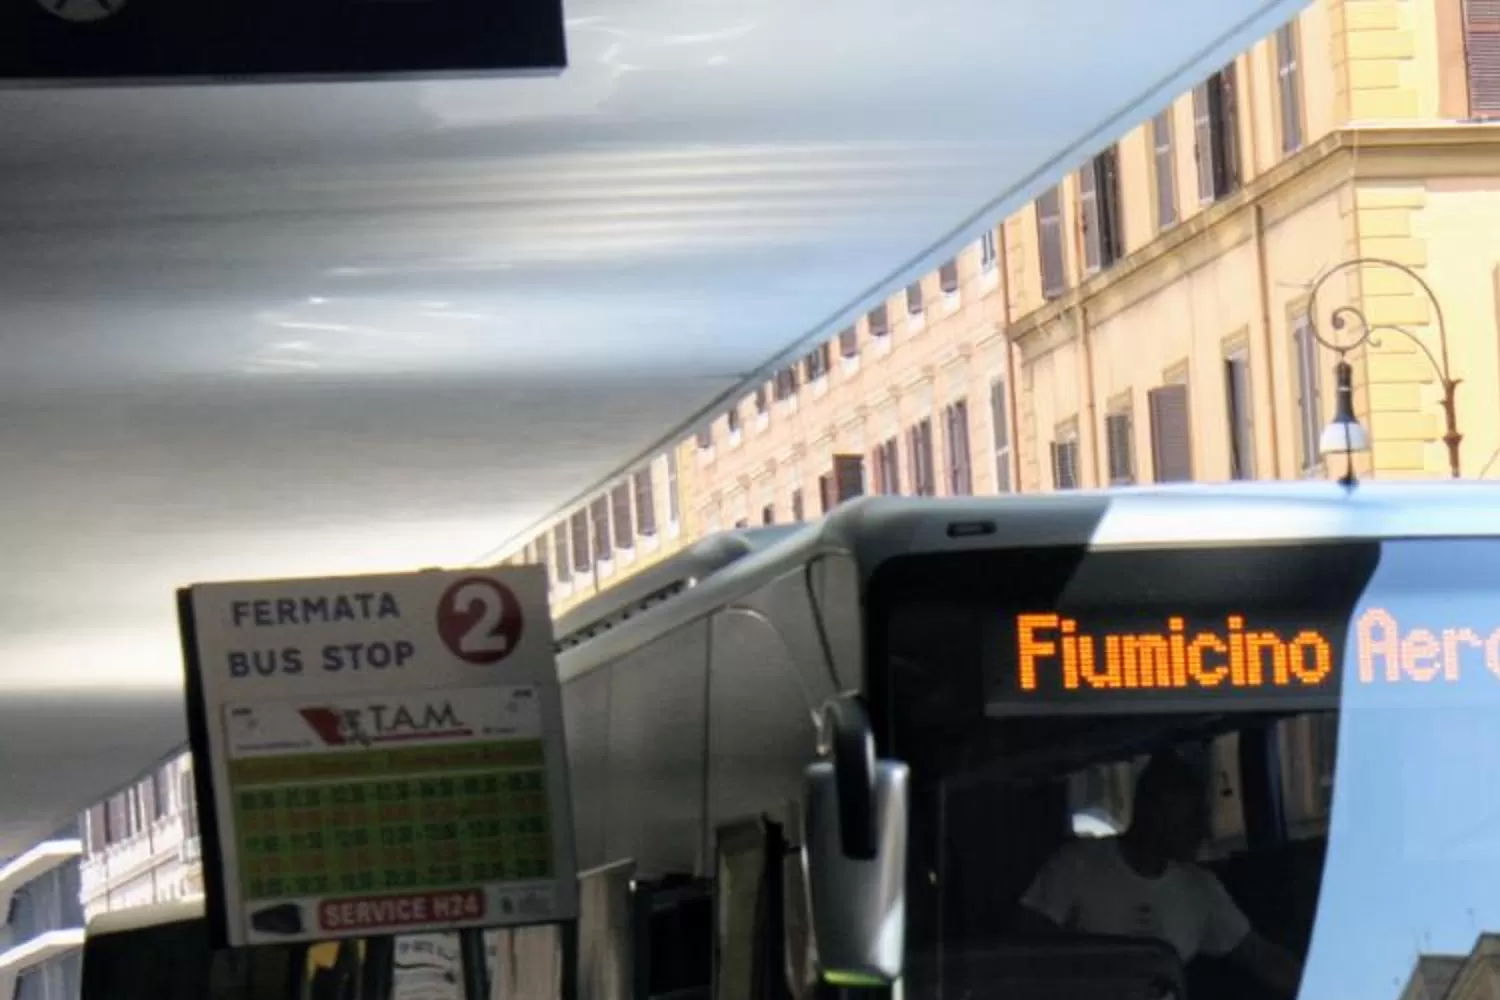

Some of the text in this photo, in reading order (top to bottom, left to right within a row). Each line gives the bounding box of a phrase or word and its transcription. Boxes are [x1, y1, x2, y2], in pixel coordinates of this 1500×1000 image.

[231, 592, 401, 627] FERMATA
[453, 581, 507, 653] 2
[228, 640, 415, 678] BUS STOP
[1016, 613, 1333, 690] Fiumicino
[324, 897, 428, 927] SERVICE
[432, 890, 480, 917] H24
